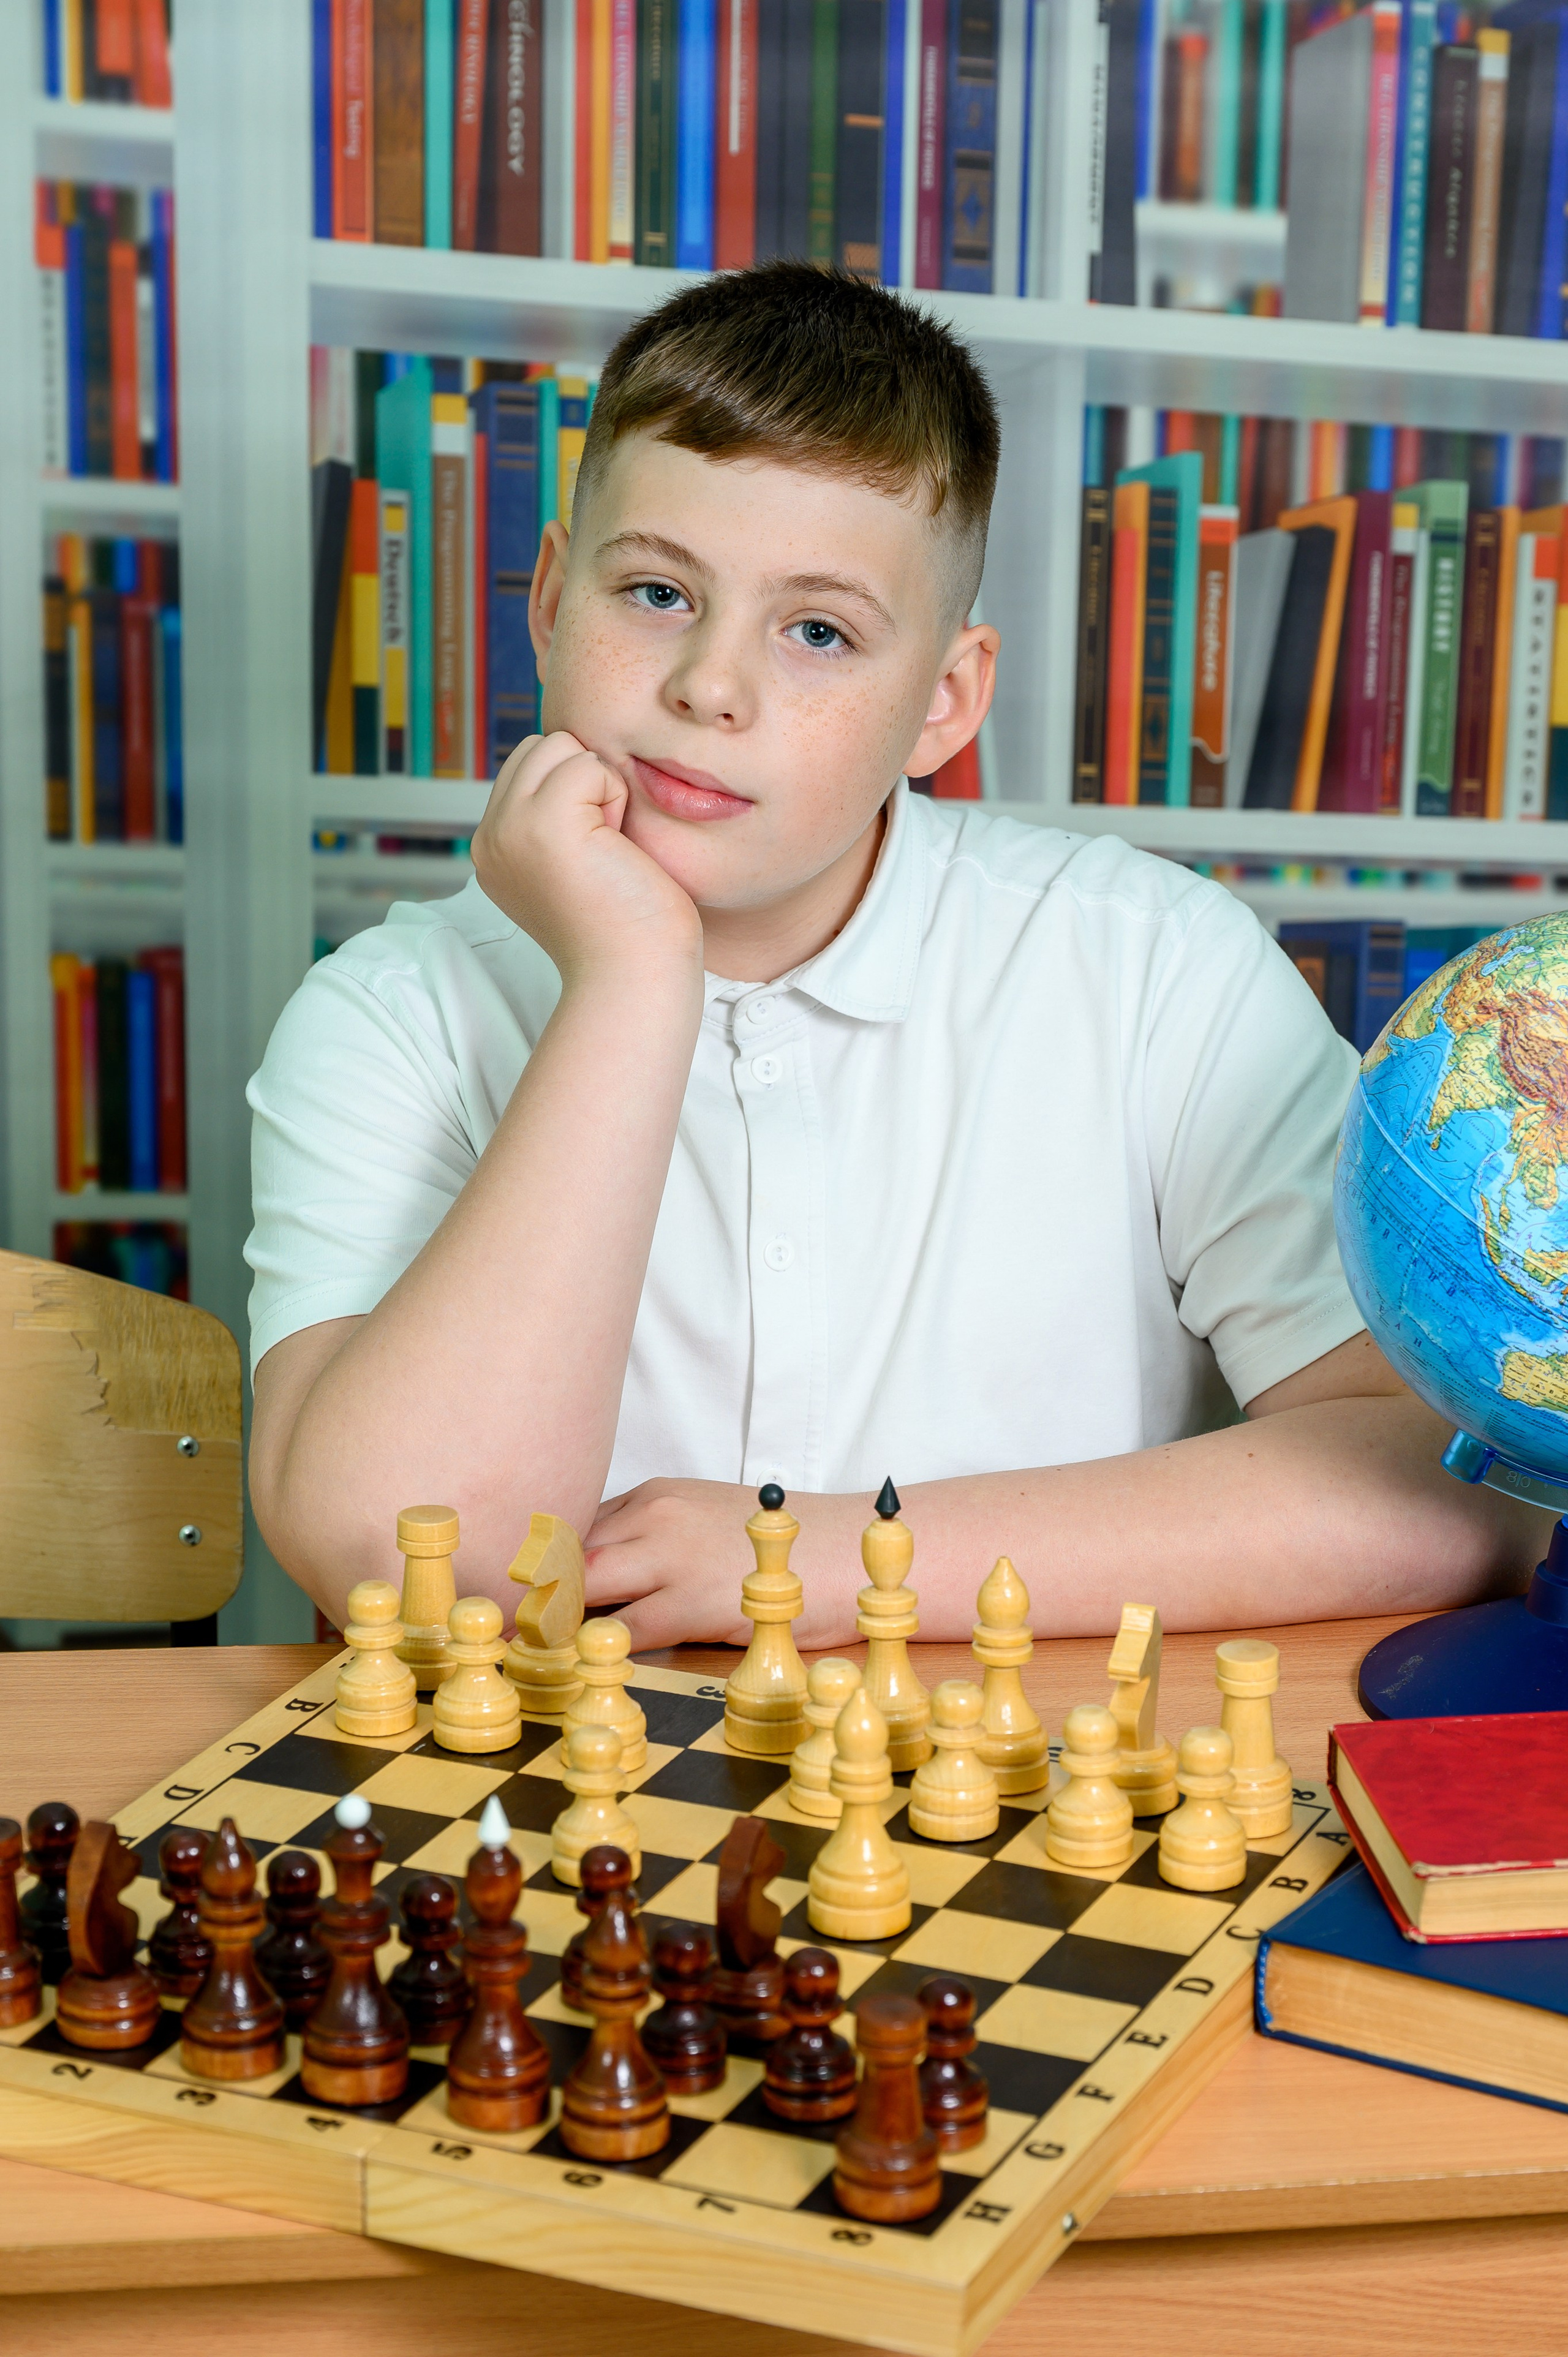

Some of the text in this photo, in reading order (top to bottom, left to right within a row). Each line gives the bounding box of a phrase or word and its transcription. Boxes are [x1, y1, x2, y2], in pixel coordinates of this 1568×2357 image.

[384, 538, 402, 643] Deutsch
[1201, 570, 1225, 692] Literature
[285, 1697, 324, 1713] B
[225, 1741, 261, 1756] C
[164, 1784, 205, 1801] D
[1316, 1832, 1351, 1847] A
[1268, 1876, 1309, 1893] B
[1226, 1925, 1264, 1941] C
[1173, 1976, 1216, 1997] D
[1125, 2031, 1170, 2050] E
[53, 2062, 93, 2081] 2
[176, 2087, 218, 2107] 3
[1074, 2084, 1116, 2103] F
[305, 2115, 344, 2132] 4
[431, 2141, 473, 2160] 5
[1023, 2143, 1066, 2160] G
[562, 2169, 603, 2189] 6
[697, 2193, 738, 2214] 7
[963, 2201, 1012, 2225] H
[831, 2227, 873, 2246] 8
